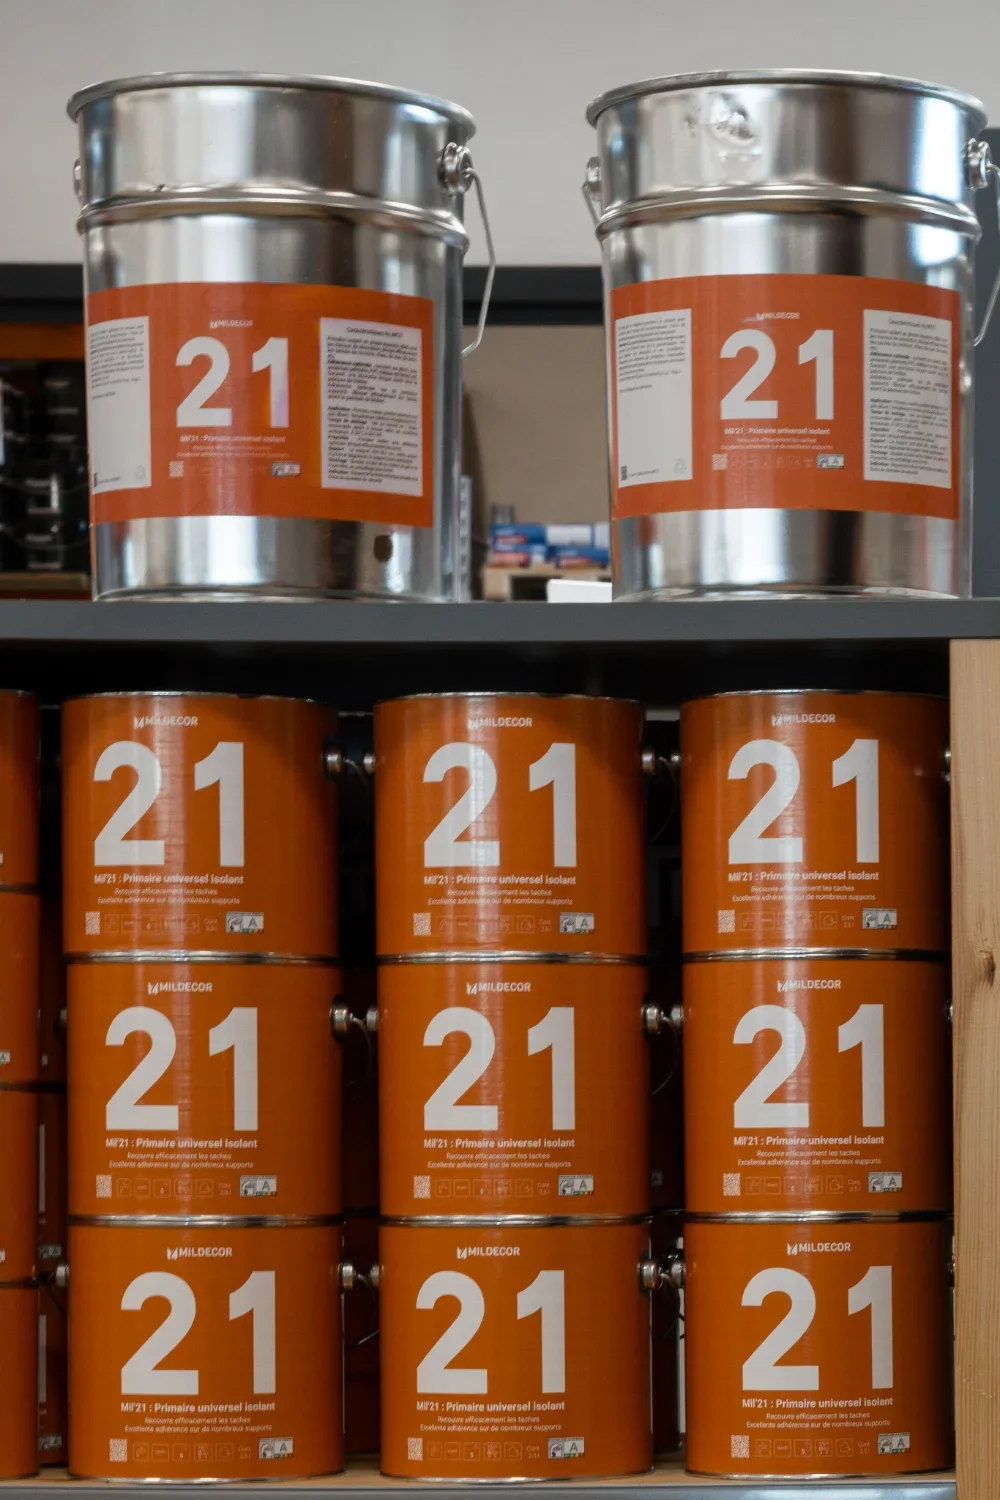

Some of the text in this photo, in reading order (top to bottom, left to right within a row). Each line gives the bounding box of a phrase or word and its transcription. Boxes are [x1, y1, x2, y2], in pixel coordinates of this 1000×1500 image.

[720, 328, 834, 420] 21
[175, 335, 290, 428] 21
[144, 715, 199, 727] MILDECOR
[480, 717, 533, 728] MILDECOR
[784, 714, 836, 723] MILDECOR
[93, 740, 244, 867] 21
[423, 742, 577, 867] 21
[727, 739, 879, 864] 21
[160, 982, 213, 993] MILDECOR
[479, 982, 531, 992] MILDECOR
[789, 980, 841, 989] MILDECOR
[105, 1006, 259, 1131] 21
[423, 1007, 576, 1131] 21
[733, 1004, 885, 1129] 21
[136, 1138, 175, 1148] Primaire
[177, 1138, 223, 1148] universel
[225, 1139, 257, 1148] isolant
[455, 1138, 494, 1148] Primaire
[497, 1138, 541, 1148] universel
[543, 1138, 575, 1147] isolant
[766, 1136, 806, 1146] Primaire
[808, 1136, 852, 1146] universel
[854, 1135, 884, 1144] isolant
[179, 1247, 232, 1258] MILDECOR
[468, 1246, 520, 1256] MILDECOR
[799, 1242, 850, 1252] MILDECOR
[120, 1270, 276, 1396] 21
[416, 1269, 565, 1394] 21
[741, 1265, 893, 1391] 21
[154, 1403, 195, 1412] Primaire
[197, 1403, 242, 1412] universel
[244, 1402, 275, 1411] isolant
[446, 1402, 484, 1411] Primaire
[486, 1402, 531, 1411] universel
[533, 1401, 565, 1410] isolant
[776, 1399, 816, 1408] Primaire
[818, 1398, 862, 1407] universel
[864, 1397, 893, 1406] isolant
